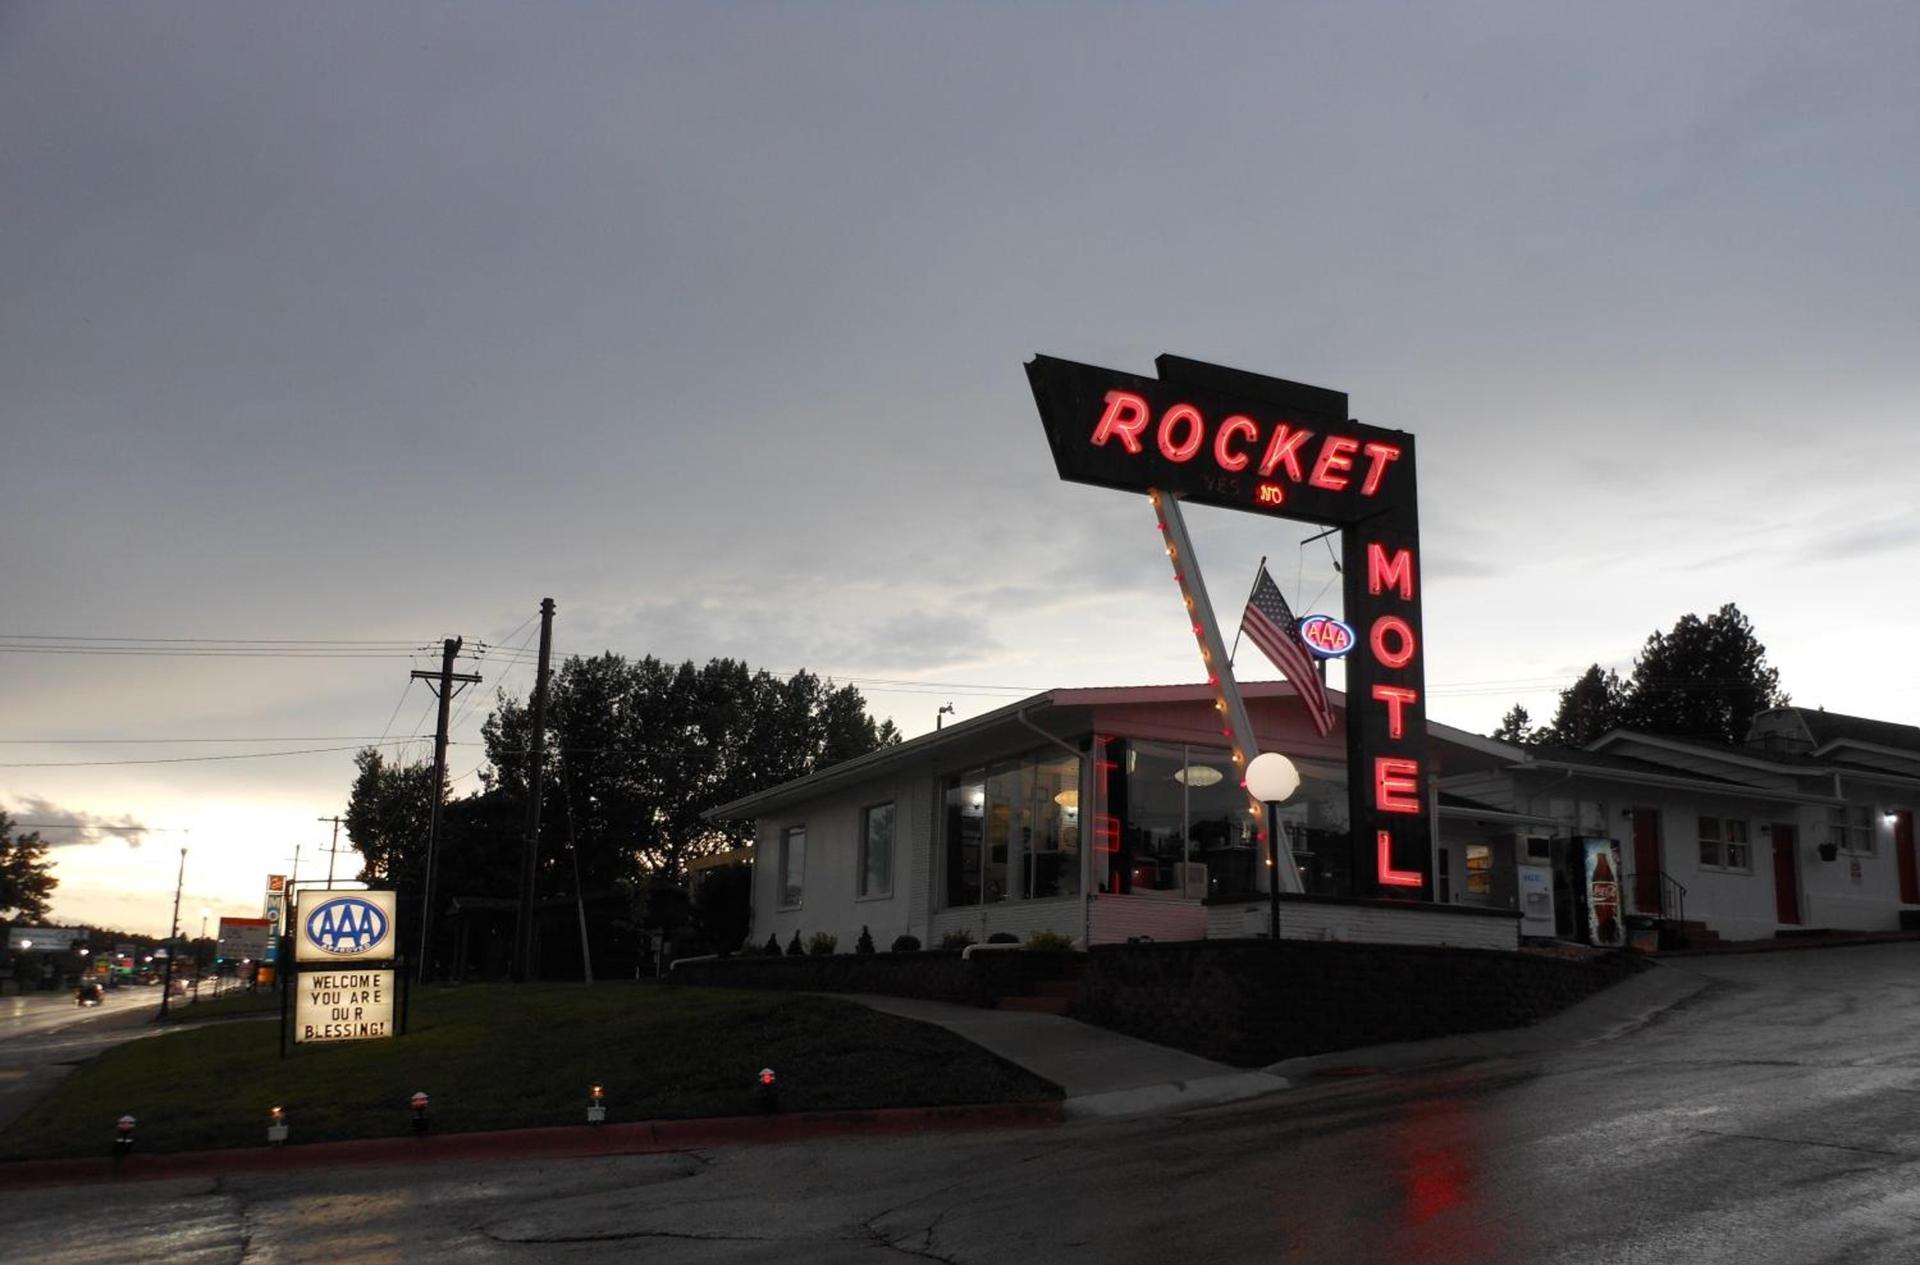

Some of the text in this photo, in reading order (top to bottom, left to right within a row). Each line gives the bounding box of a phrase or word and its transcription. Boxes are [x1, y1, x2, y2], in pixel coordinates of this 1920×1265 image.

[1090, 390, 1401, 496] ROCKET
[1205, 476, 1284, 505] YES NO
[1306, 621, 1348, 648] AAA
[1367, 543, 1423, 886] MOTEL
[317, 902, 376, 948] AAA
[321, 942, 372, 954] APPROVED
[313, 974, 381, 989] WELCOME
[311, 990, 381, 1005] YOU ARE
[332, 1007, 363, 1021] OUR
[305, 1022, 385, 1039] BLESSING!
